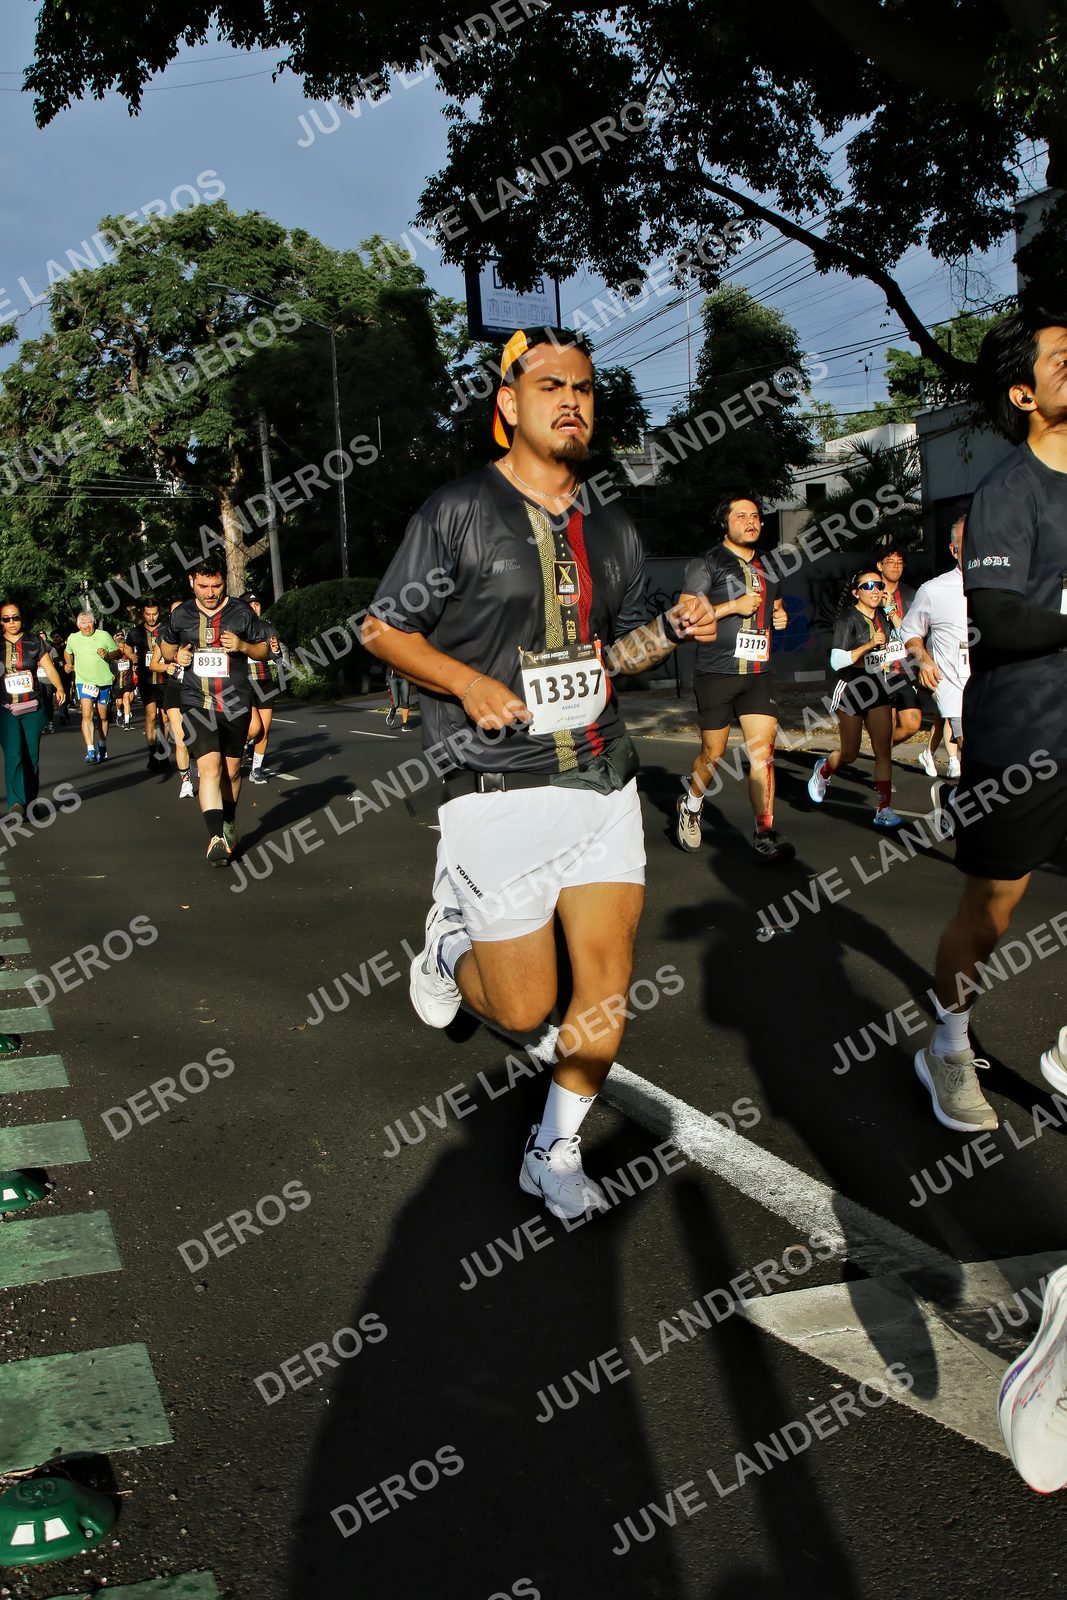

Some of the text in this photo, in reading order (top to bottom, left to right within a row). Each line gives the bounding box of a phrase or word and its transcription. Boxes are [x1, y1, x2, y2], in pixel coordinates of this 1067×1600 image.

[982, 556, 1011, 567] GDL
[738, 637, 767, 650] 13119
[198, 656, 222, 667] 8933
[7, 677, 30, 688] 11623
[528, 668, 602, 705] 13337
[561, 703, 580, 711] AVALOS
[456, 864, 484, 900] TOPTIME
